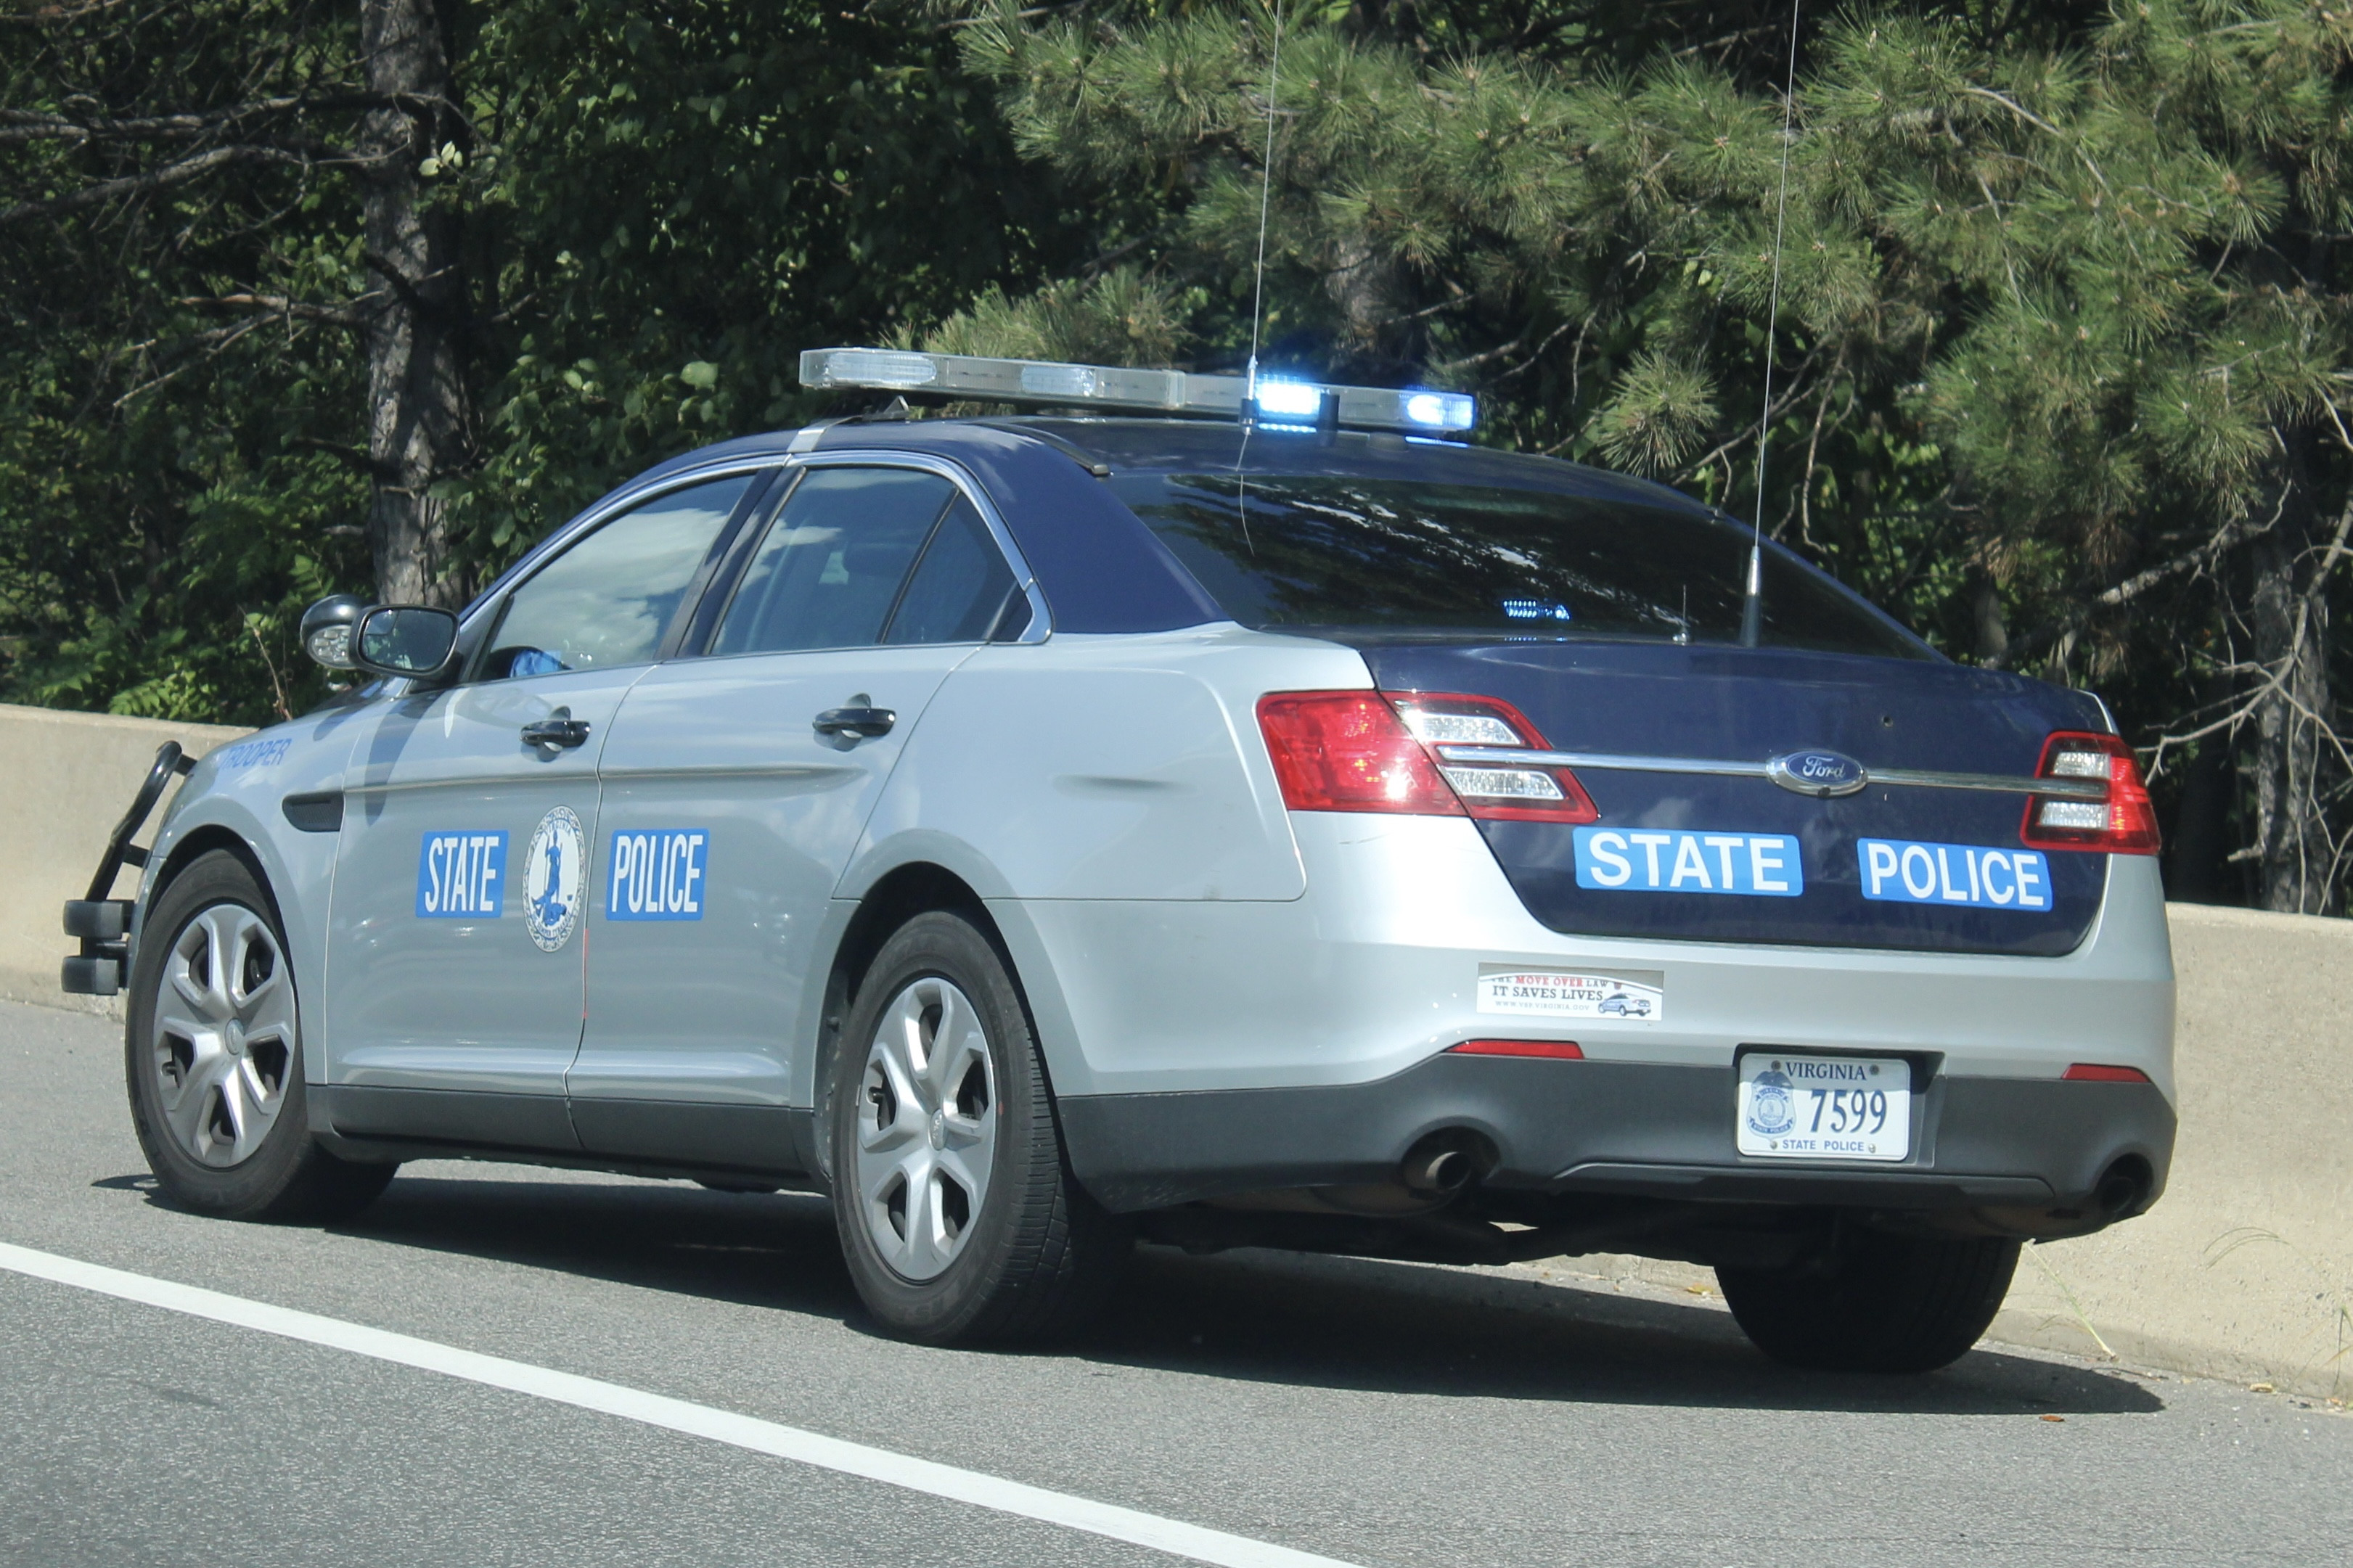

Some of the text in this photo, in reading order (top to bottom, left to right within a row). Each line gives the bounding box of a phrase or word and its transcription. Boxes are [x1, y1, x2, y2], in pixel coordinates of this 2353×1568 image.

[220, 739, 292, 770] TROOPER
[1803, 756, 1845, 778] Ford
[425, 834, 703, 913] STATE POLICE
[1589, 832, 2044, 906] STATE POLICE
[1515, 975, 1550, 985] MOVE
[1553, 977, 1584, 988] OVER
[1586, 980, 1608, 988] LAW
[1492, 985, 1603, 1001] IT SAVES LIVES
[1785, 1062, 1867, 1080] VIRGINIA
[1810, 1089, 1888, 1135] 7599
[1783, 1139, 1865, 1152] STATE POLICE
